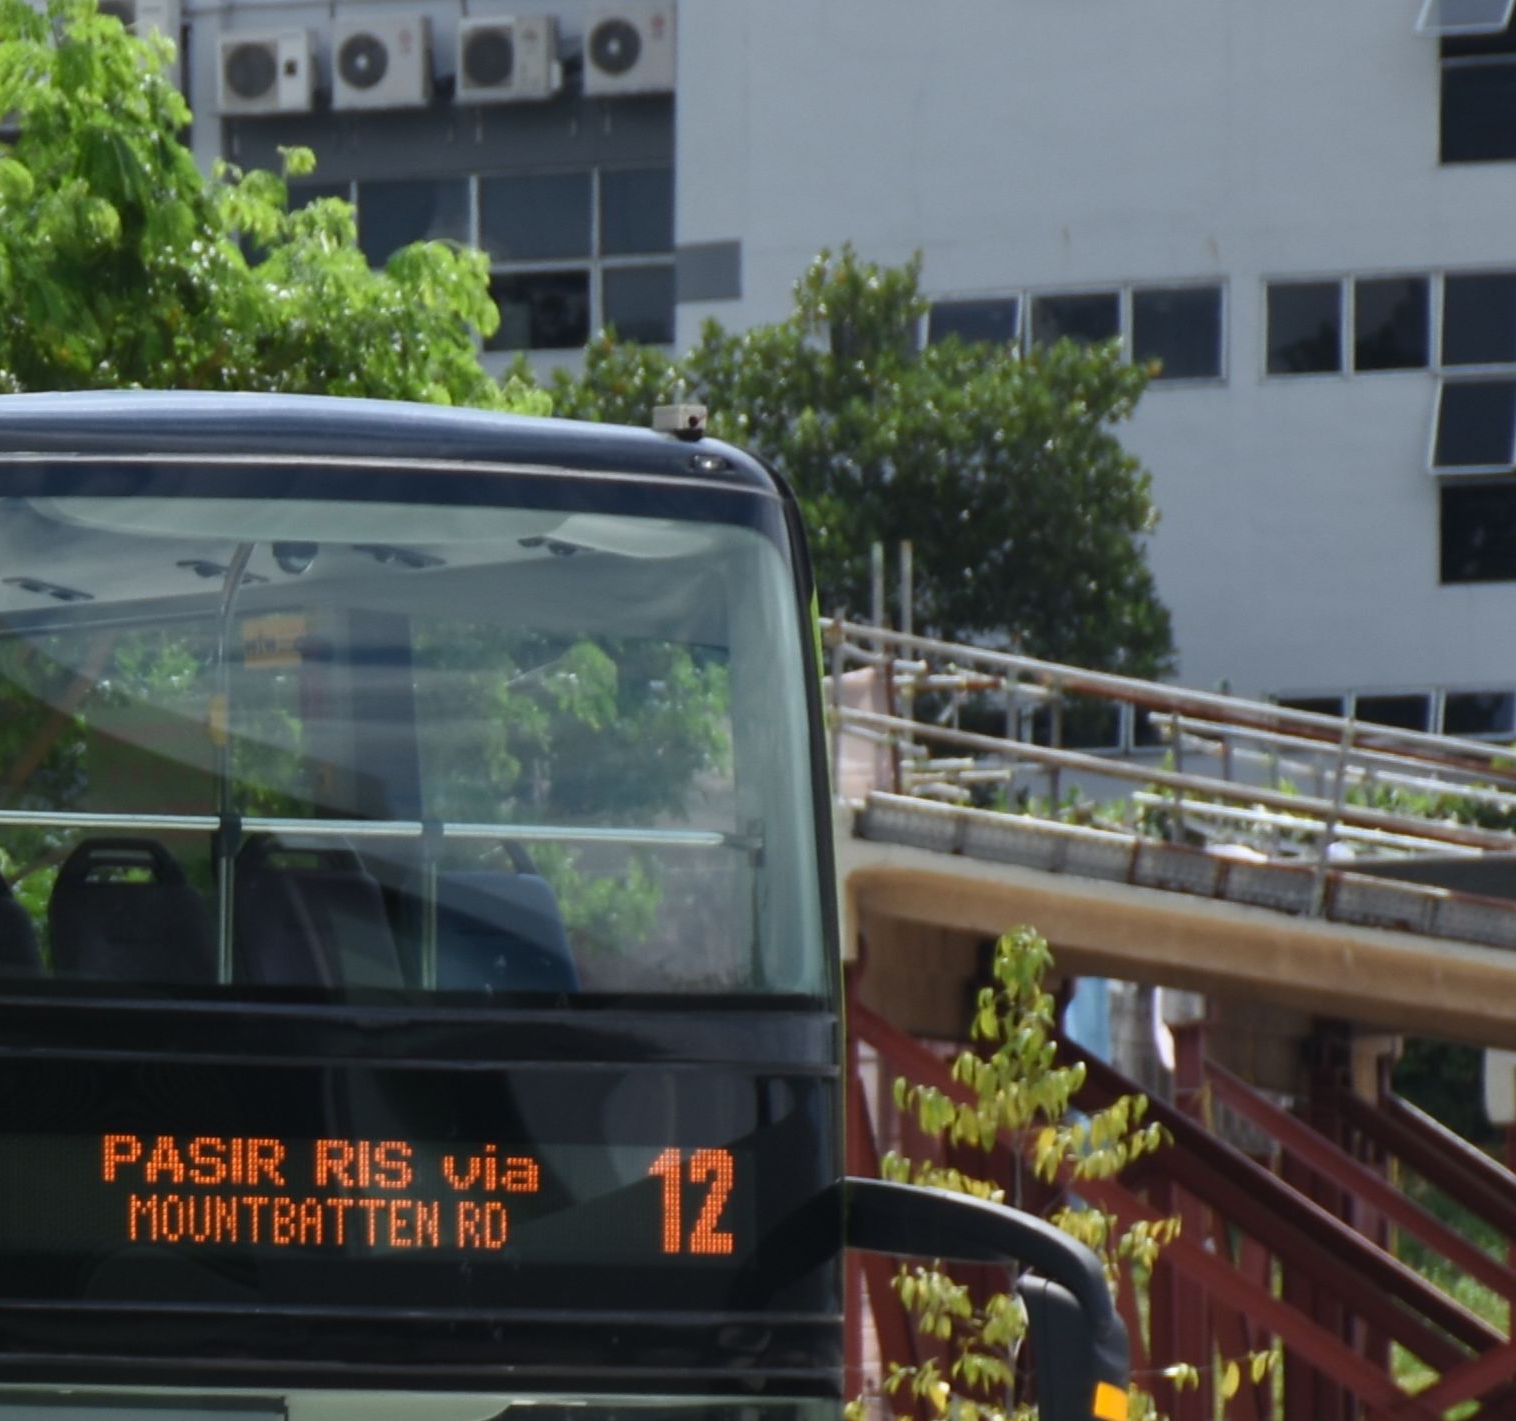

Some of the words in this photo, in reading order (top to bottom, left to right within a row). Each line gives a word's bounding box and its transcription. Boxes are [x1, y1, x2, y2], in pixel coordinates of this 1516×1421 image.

[102, 1134, 285, 1186] PASIR
[315, 1138, 413, 1189] RIS
[443, 1143, 539, 1193] via
[128, 1194, 440, 1249] MOUNTBATTEN
[457, 1200, 509, 1249] RD
[648, 1147, 734, 1254] 12
